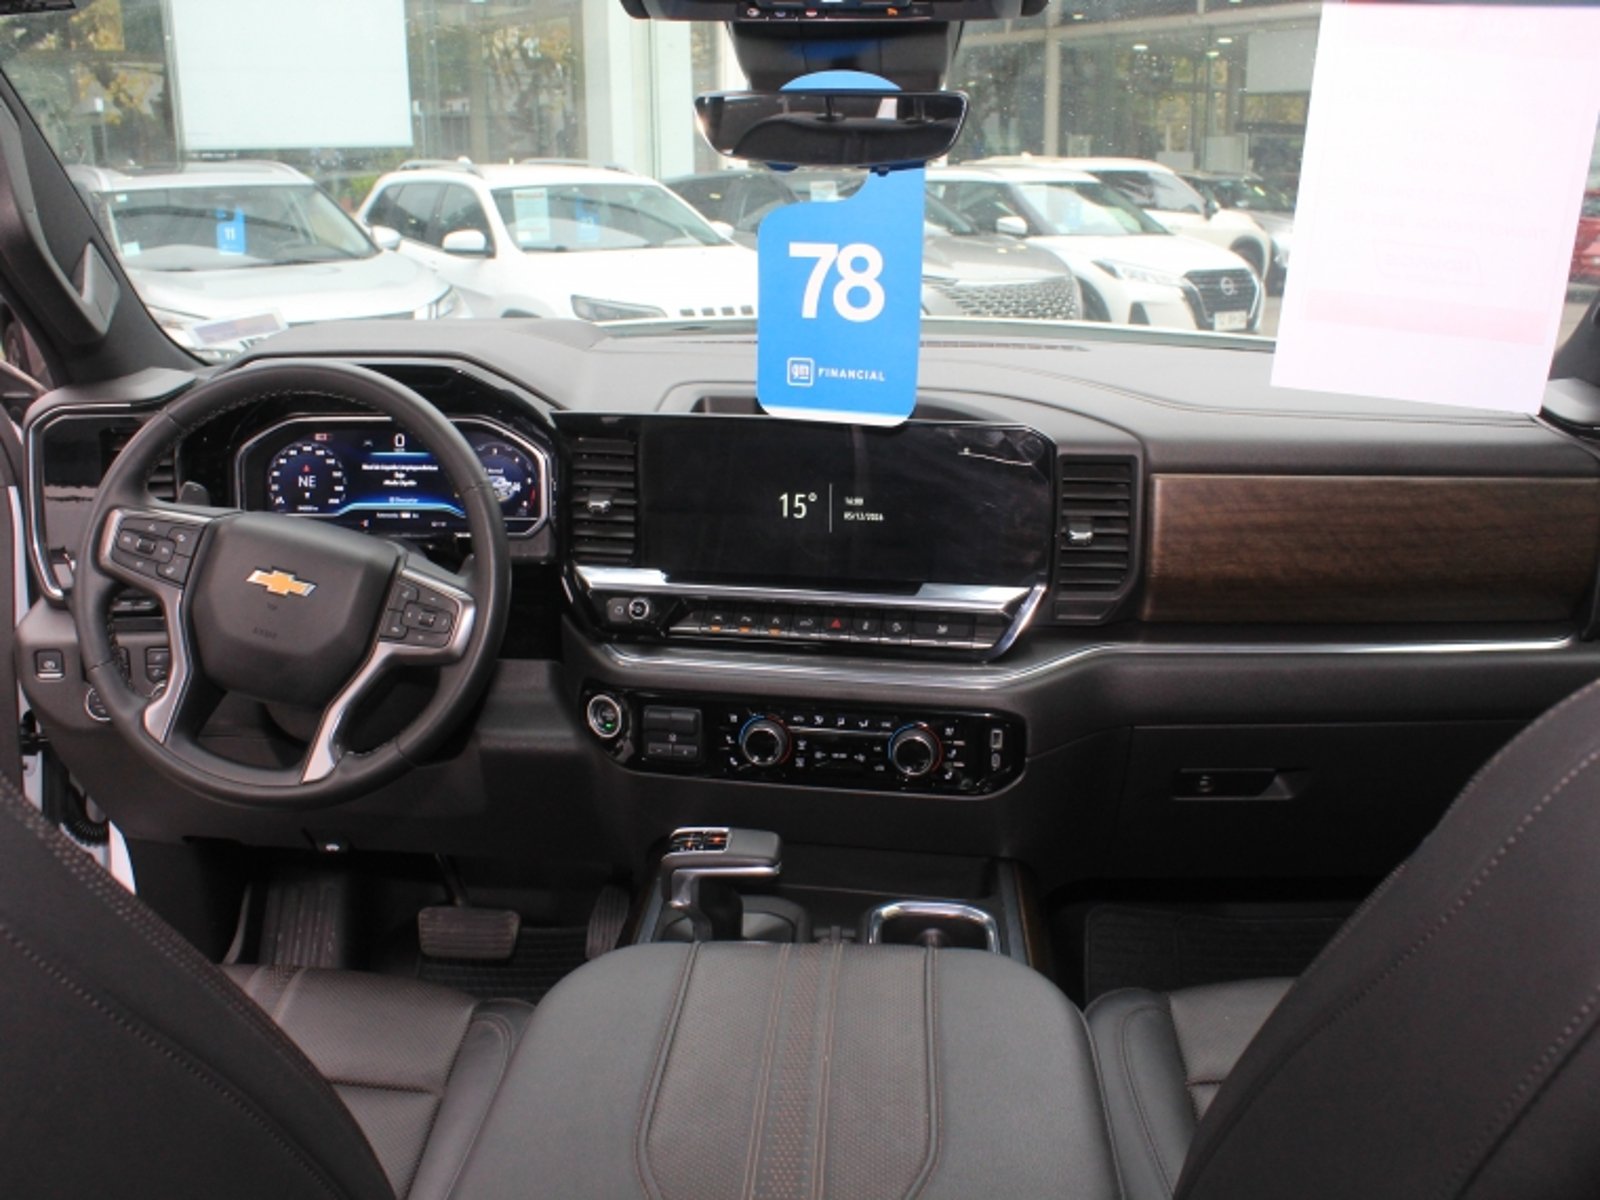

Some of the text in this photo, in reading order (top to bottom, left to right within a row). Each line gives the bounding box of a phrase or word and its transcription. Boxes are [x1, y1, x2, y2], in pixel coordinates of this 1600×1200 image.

[788, 241, 886, 323] 78
[817, 366, 886, 382] FINANCIAL
[298, 474, 317, 488] NE
[778, 491, 818, 519] 15°
